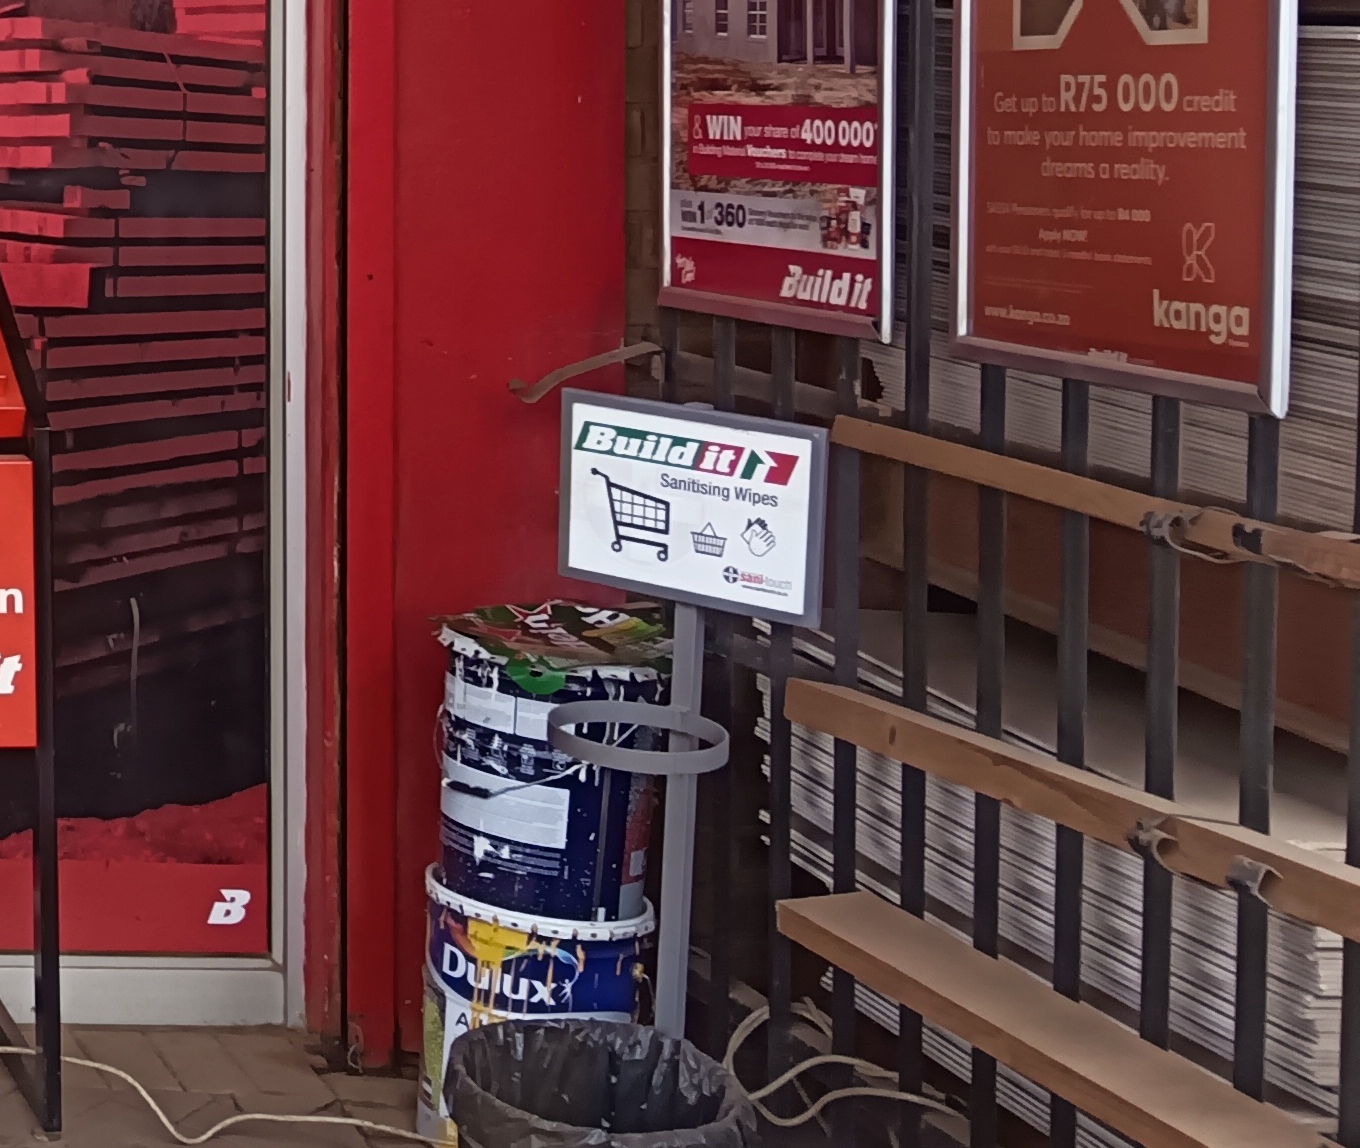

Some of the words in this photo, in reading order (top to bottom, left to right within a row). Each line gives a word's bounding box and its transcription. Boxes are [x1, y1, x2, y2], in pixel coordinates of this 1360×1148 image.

[993, 92, 1018, 113] Get
[1021, 95, 1038, 117] up
[1059, 74, 1108, 113] R75
[1117, 72, 1179, 112] 000
[1183, 89, 1237, 112] credit
[692, 115, 703, 140] &
[706, 115, 742, 141] WIN
[764, 124, 789, 139] share
[987, 126, 1001, 146] to
[1044, 130, 1076, 150] your
[1079, 124, 1124, 147] home
[1128, 125, 1247, 152] improvement
[1040, 157, 1096, 178] dreams
[713, 202, 746, 228] 360
[779, 263, 851, 306] Build
[848, 273, 873, 310] it
[1152, 288, 1250, 345] kanga
[581, 424, 698, 467] Build
[698, 444, 736, 474] it
[659, 472, 730, 502] Sanitising
[733, 486, 779, 508] Wipes
[442, 941, 559, 1007] Dulux
